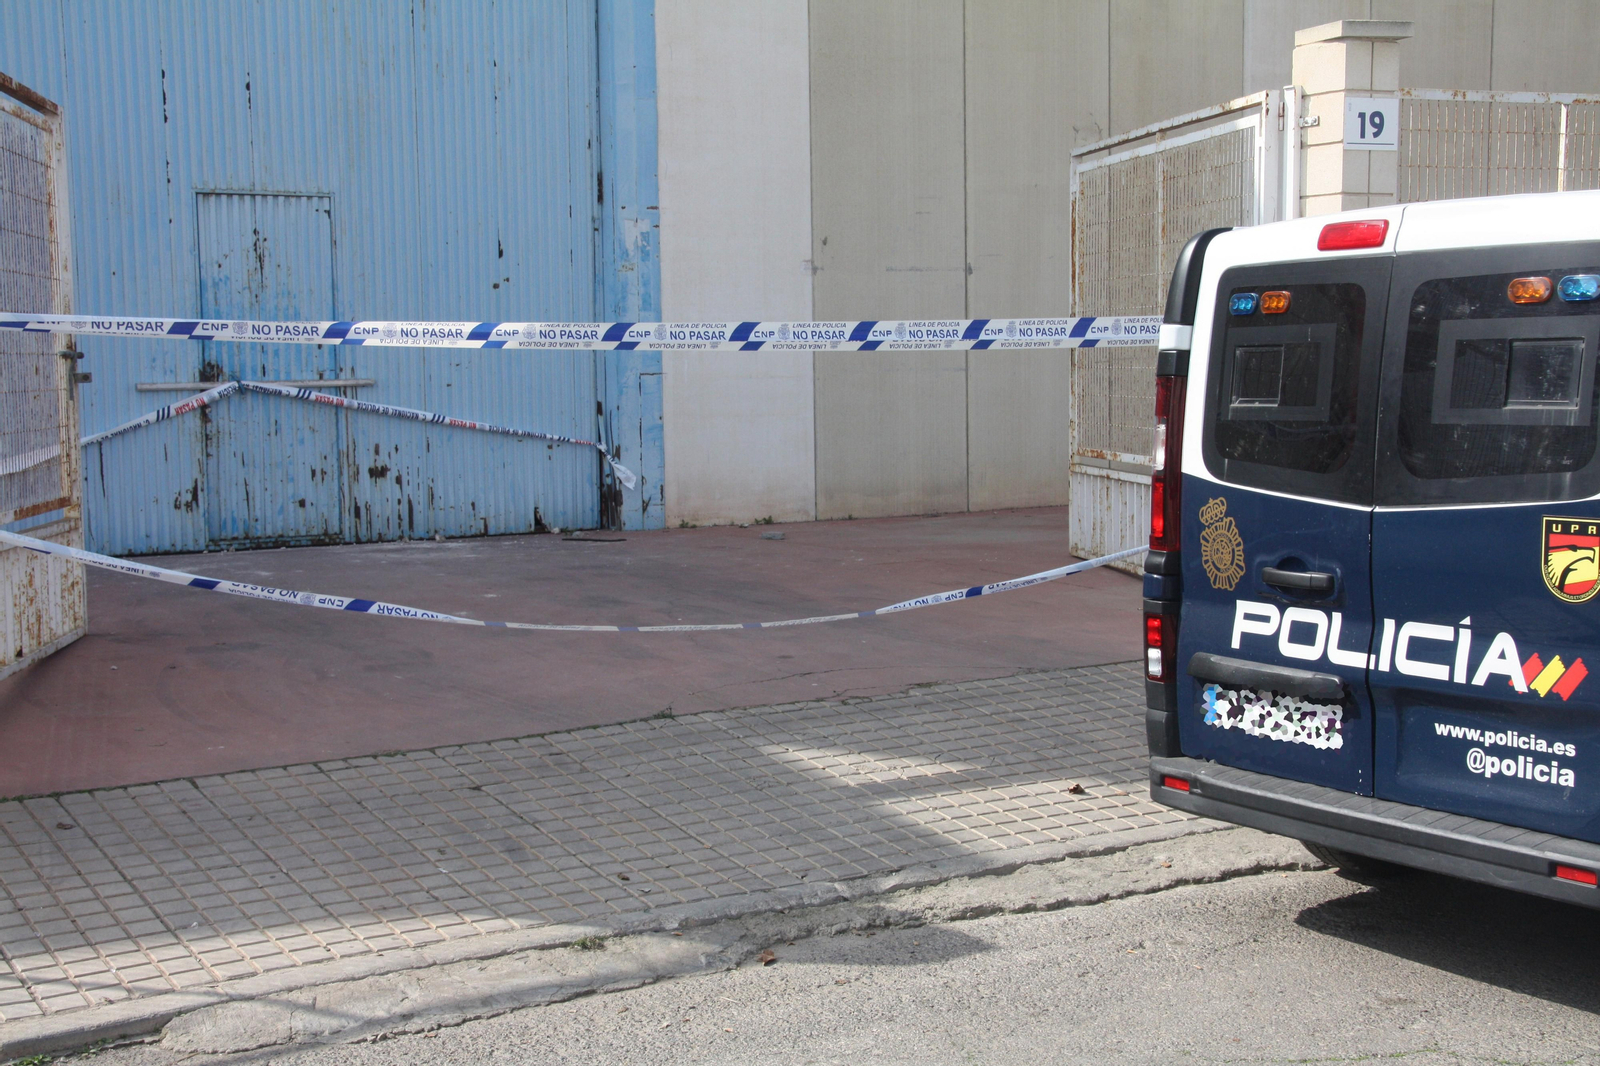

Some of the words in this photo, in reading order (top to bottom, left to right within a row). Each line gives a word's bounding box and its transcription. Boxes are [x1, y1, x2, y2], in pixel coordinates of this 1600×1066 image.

[1358, 111, 1385, 139] 19
[91, 321, 110, 330] NO
[117, 321, 164, 332] PASAR
[201, 323, 229, 332] CNP
[252, 324, 271, 336] NO
[276, 325, 320, 337] PASAR
[984, 328, 1004, 336] CNP
[1019, 328, 1033, 337] NO
[1036, 327, 1067, 337] PASAR
[1091, 326, 1109, 334] CNP
[1124, 326, 1137, 335] NO
[354, 327, 379, 335] CNP
[400, 328, 418, 338] NO
[422, 329, 464, 339] PASAR
[496, 329, 520, 337] CNP
[539, 329, 556, 339] NO
[560, 330, 599, 340] PASAR
[670, 331, 686, 340] NO
[690, 331, 726, 341] PASAR
[793, 331, 808, 340] NO
[811, 331, 846, 340] PASAR
[909, 330, 924, 339] NO
[926, 329, 960, 338] PASAR
[196, 397, 206, 406] NO
[174, 401, 195, 416] PASAR
[318, 597, 344, 608] CNP
[945, 592, 964, 602] CNP
[1231, 599, 1528, 693] POLICÍA
[1434, 723, 1576, 757] www.policia.es
[1466, 747, 1575, 788] @policia
